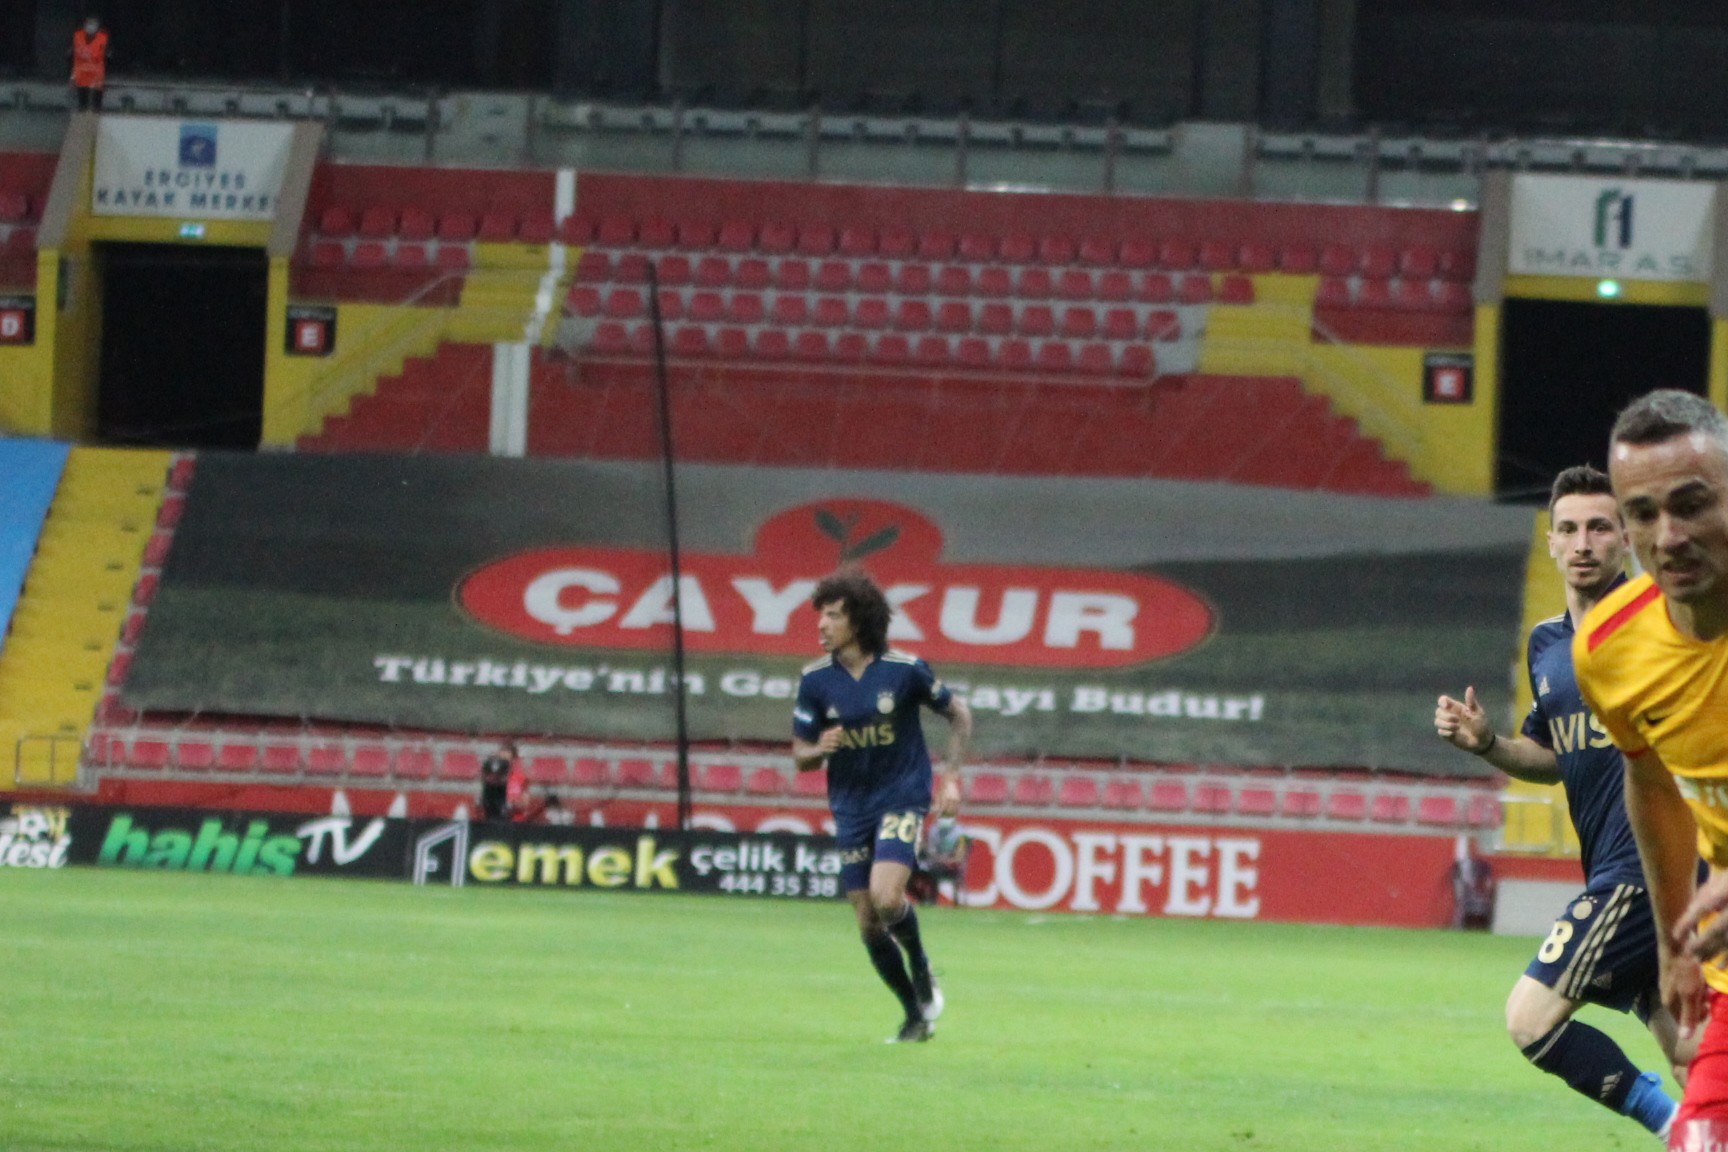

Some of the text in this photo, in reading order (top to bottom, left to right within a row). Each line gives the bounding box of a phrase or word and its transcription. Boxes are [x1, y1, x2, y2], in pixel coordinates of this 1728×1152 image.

[189, 192, 276, 212] MERKE
[1071, 684, 1264, 721] Budur!
[879, 811, 917, 844] 20
[469, 836, 681, 889] emek
[690, 842, 788, 875] çelik
[718, 875, 838, 897] 444 35 38
[1537, 920, 1574, 964] 8
